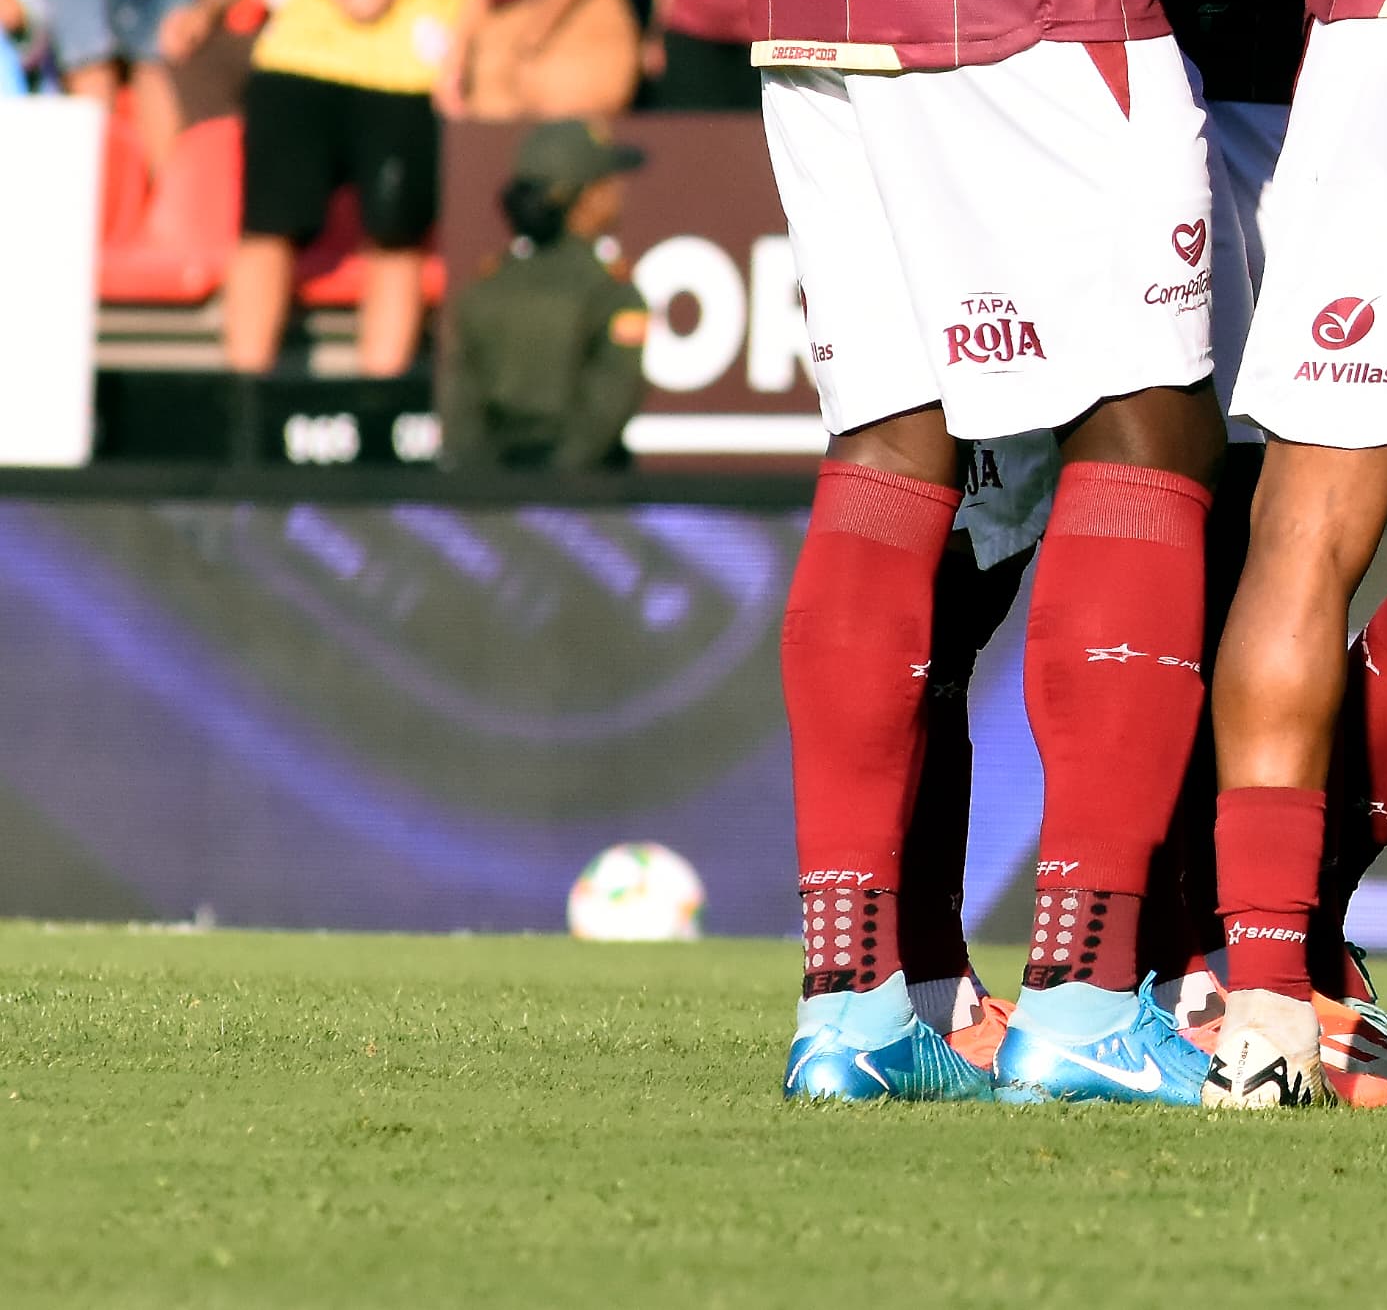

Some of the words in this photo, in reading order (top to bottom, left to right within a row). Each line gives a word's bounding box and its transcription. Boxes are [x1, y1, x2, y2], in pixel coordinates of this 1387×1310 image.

[960, 297, 1019, 317] TAPA
[942, 317, 1048, 367] ROJA
[1293, 361, 1329, 382] AV
[1157, 655, 1201, 674] SHE
[1246, 925, 1307, 946] SHEFFY
